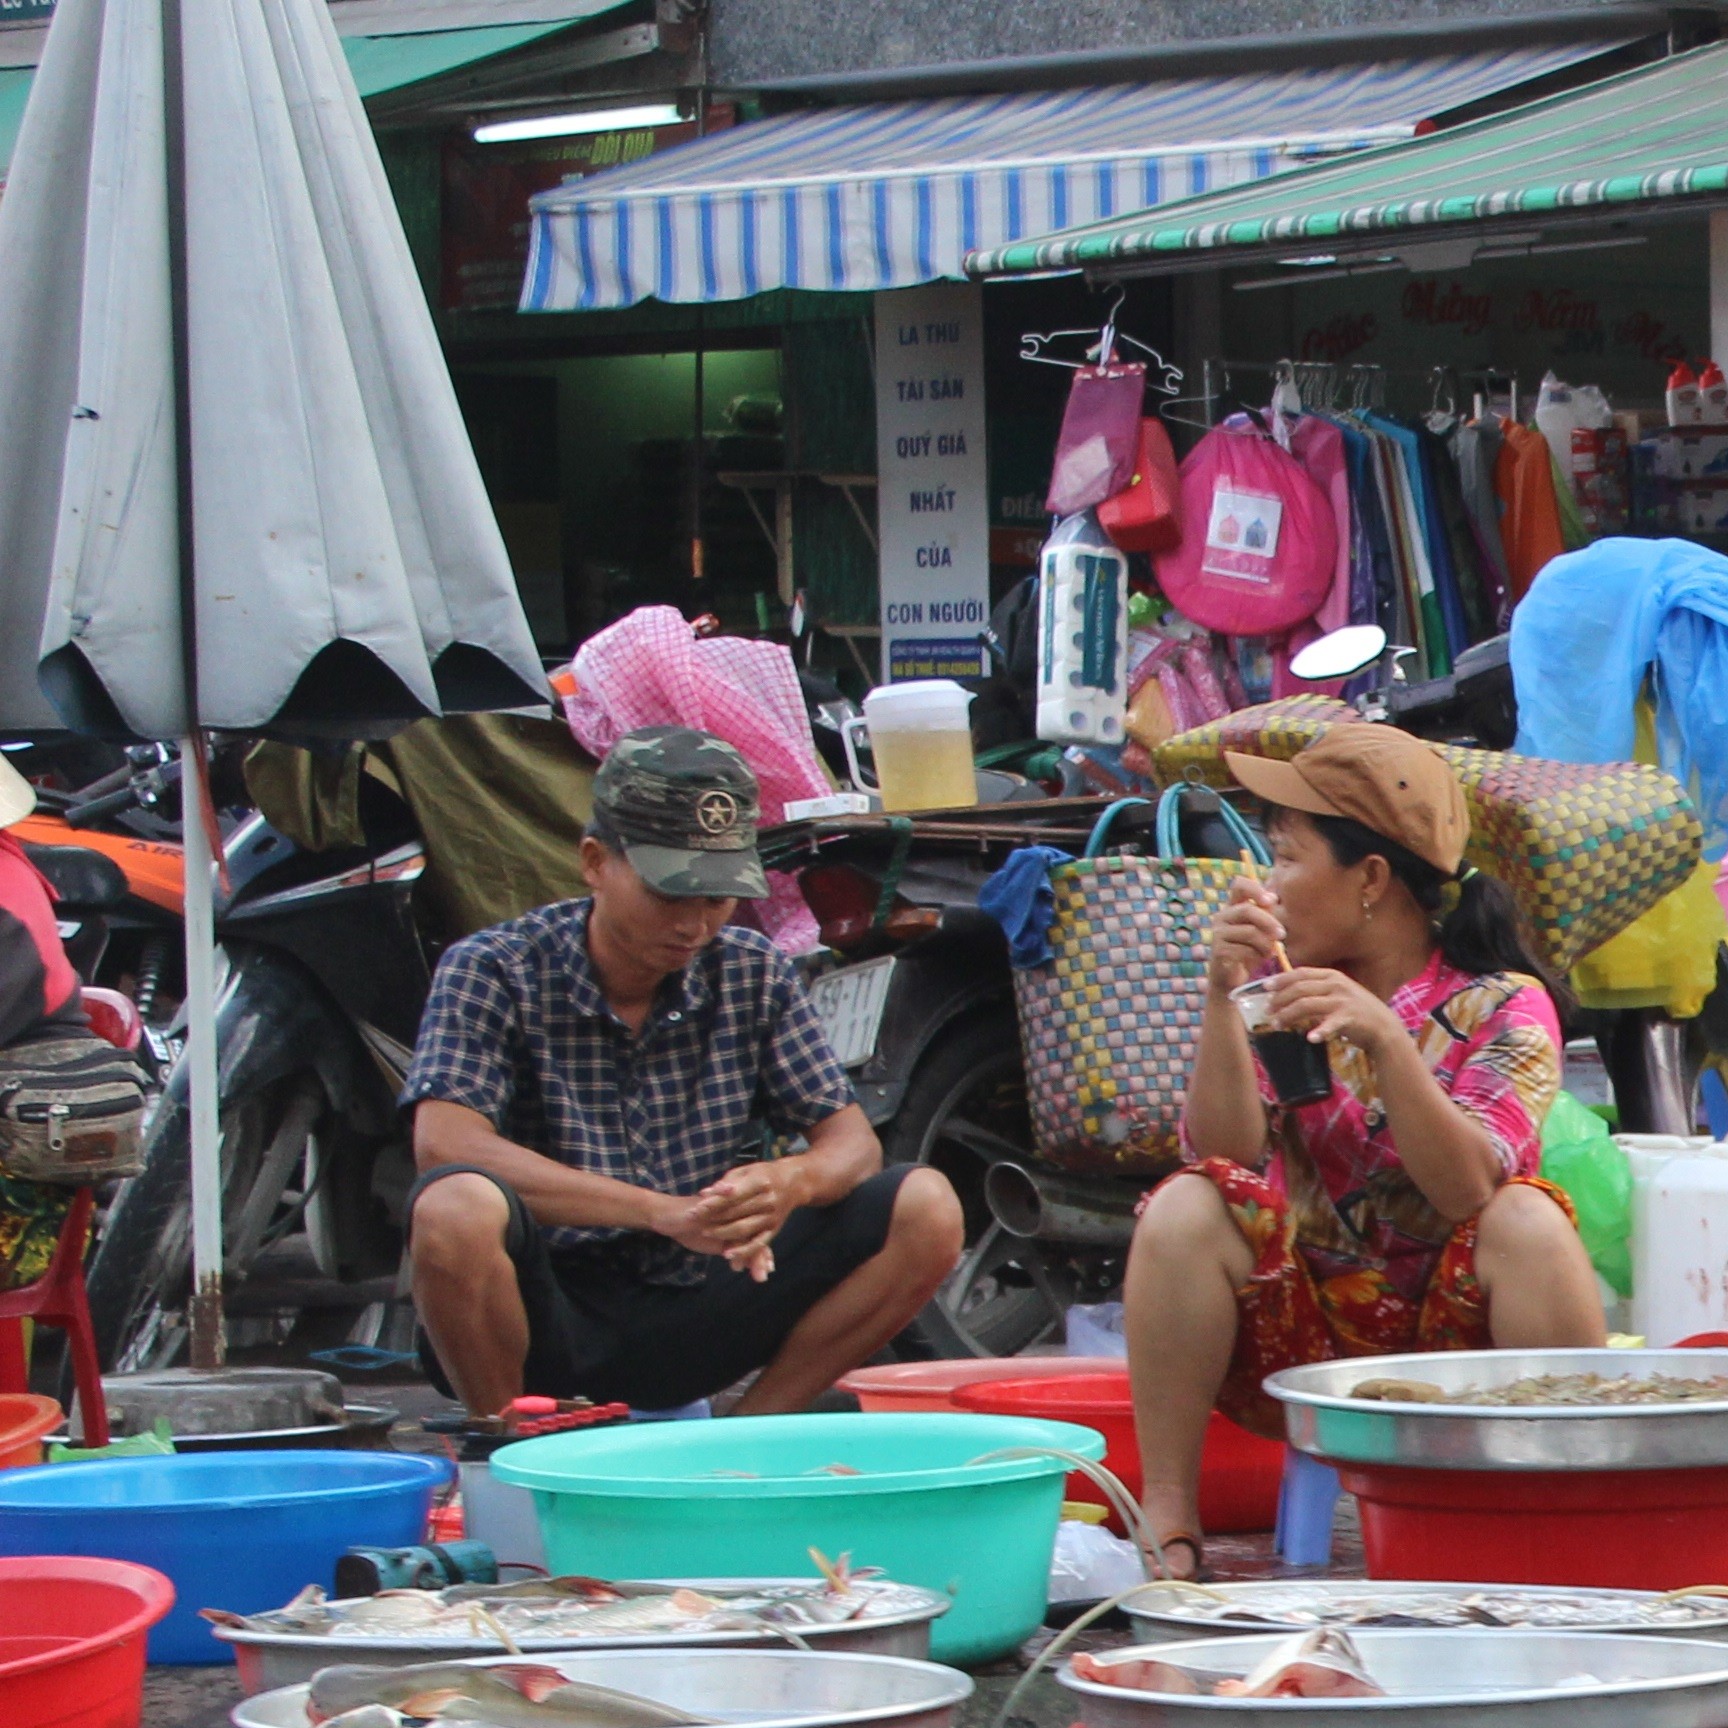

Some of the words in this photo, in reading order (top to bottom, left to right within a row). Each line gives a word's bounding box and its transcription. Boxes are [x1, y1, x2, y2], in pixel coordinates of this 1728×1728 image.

[909, 484, 957, 514] NHẤT
[915, 540, 953, 568] CỦA
[887, 602, 923, 624] CON
[928, 597, 984, 623] NGƯỜI
